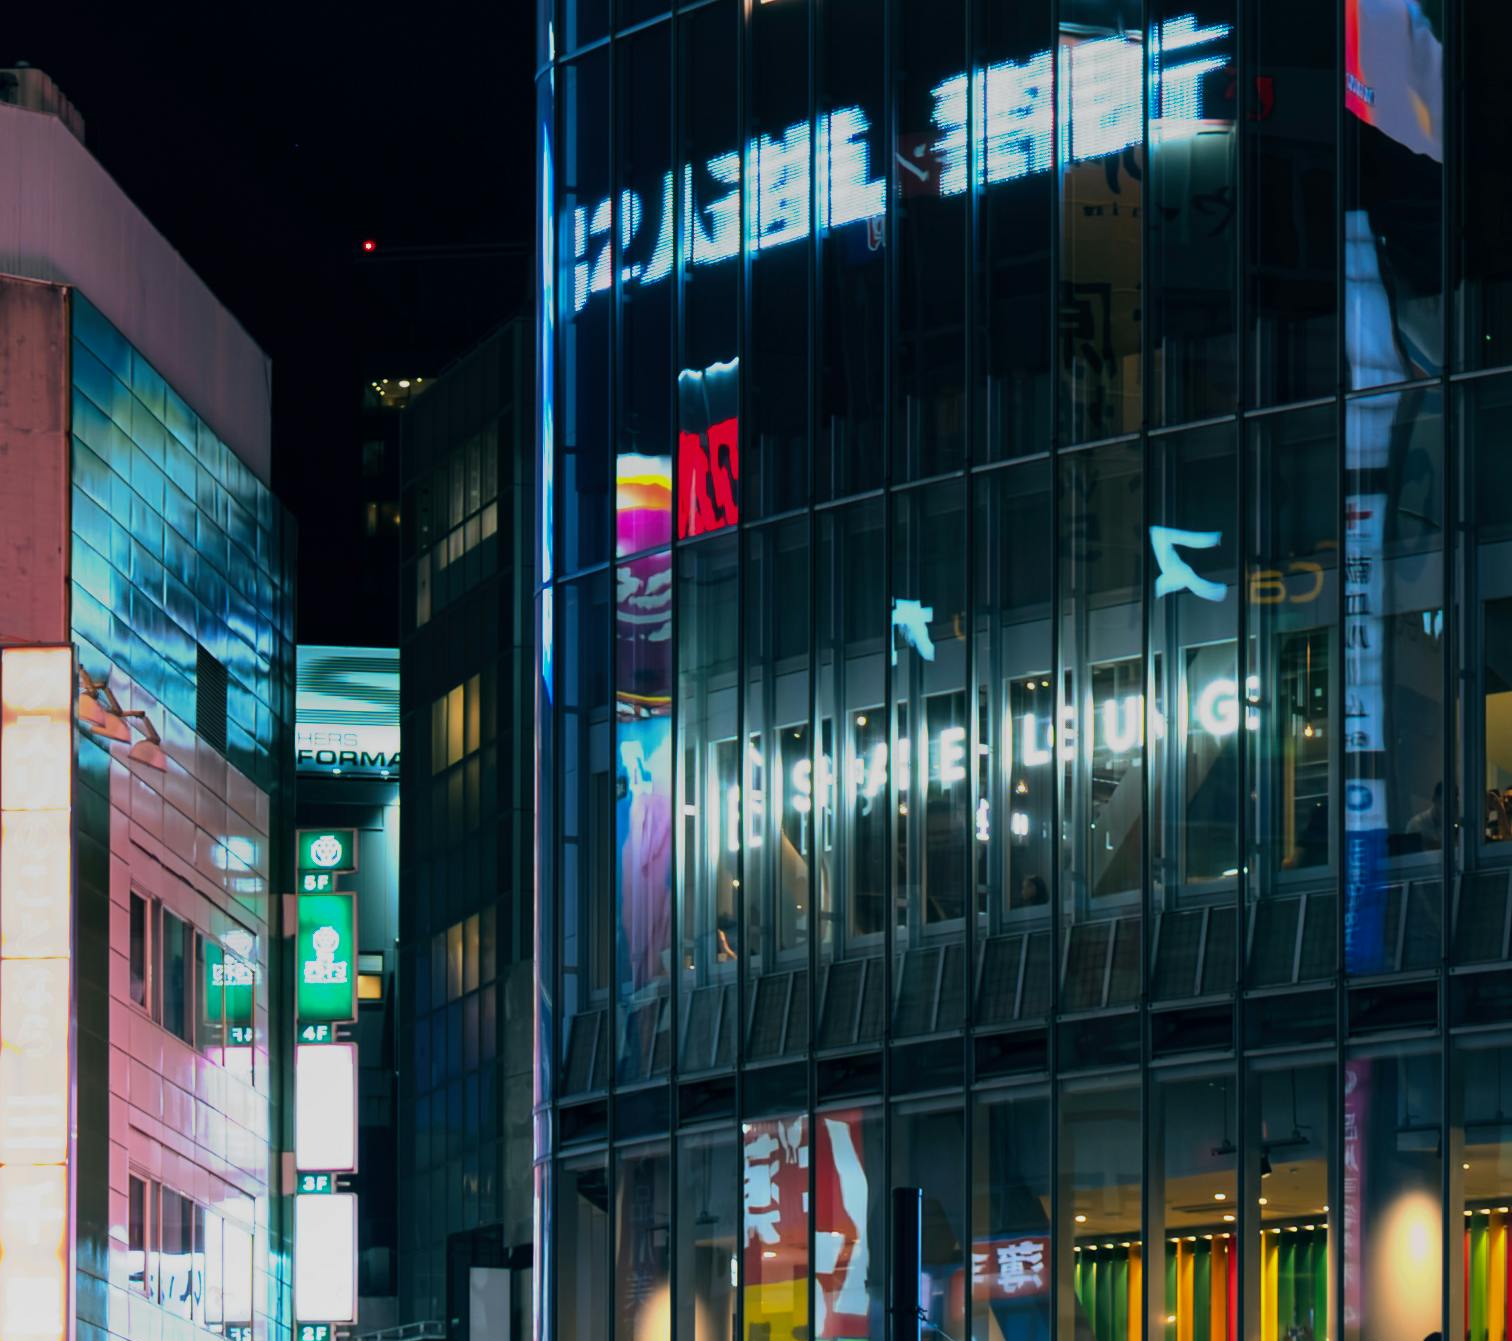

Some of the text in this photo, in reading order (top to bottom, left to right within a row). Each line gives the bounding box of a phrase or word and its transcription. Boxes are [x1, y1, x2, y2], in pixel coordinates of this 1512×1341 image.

[303, 875, 329, 891] 5F
[302, 1025, 328, 1040] 4F
[302, 1176, 328, 1191] 3F
[302, 1327, 328, 1341] 2F
